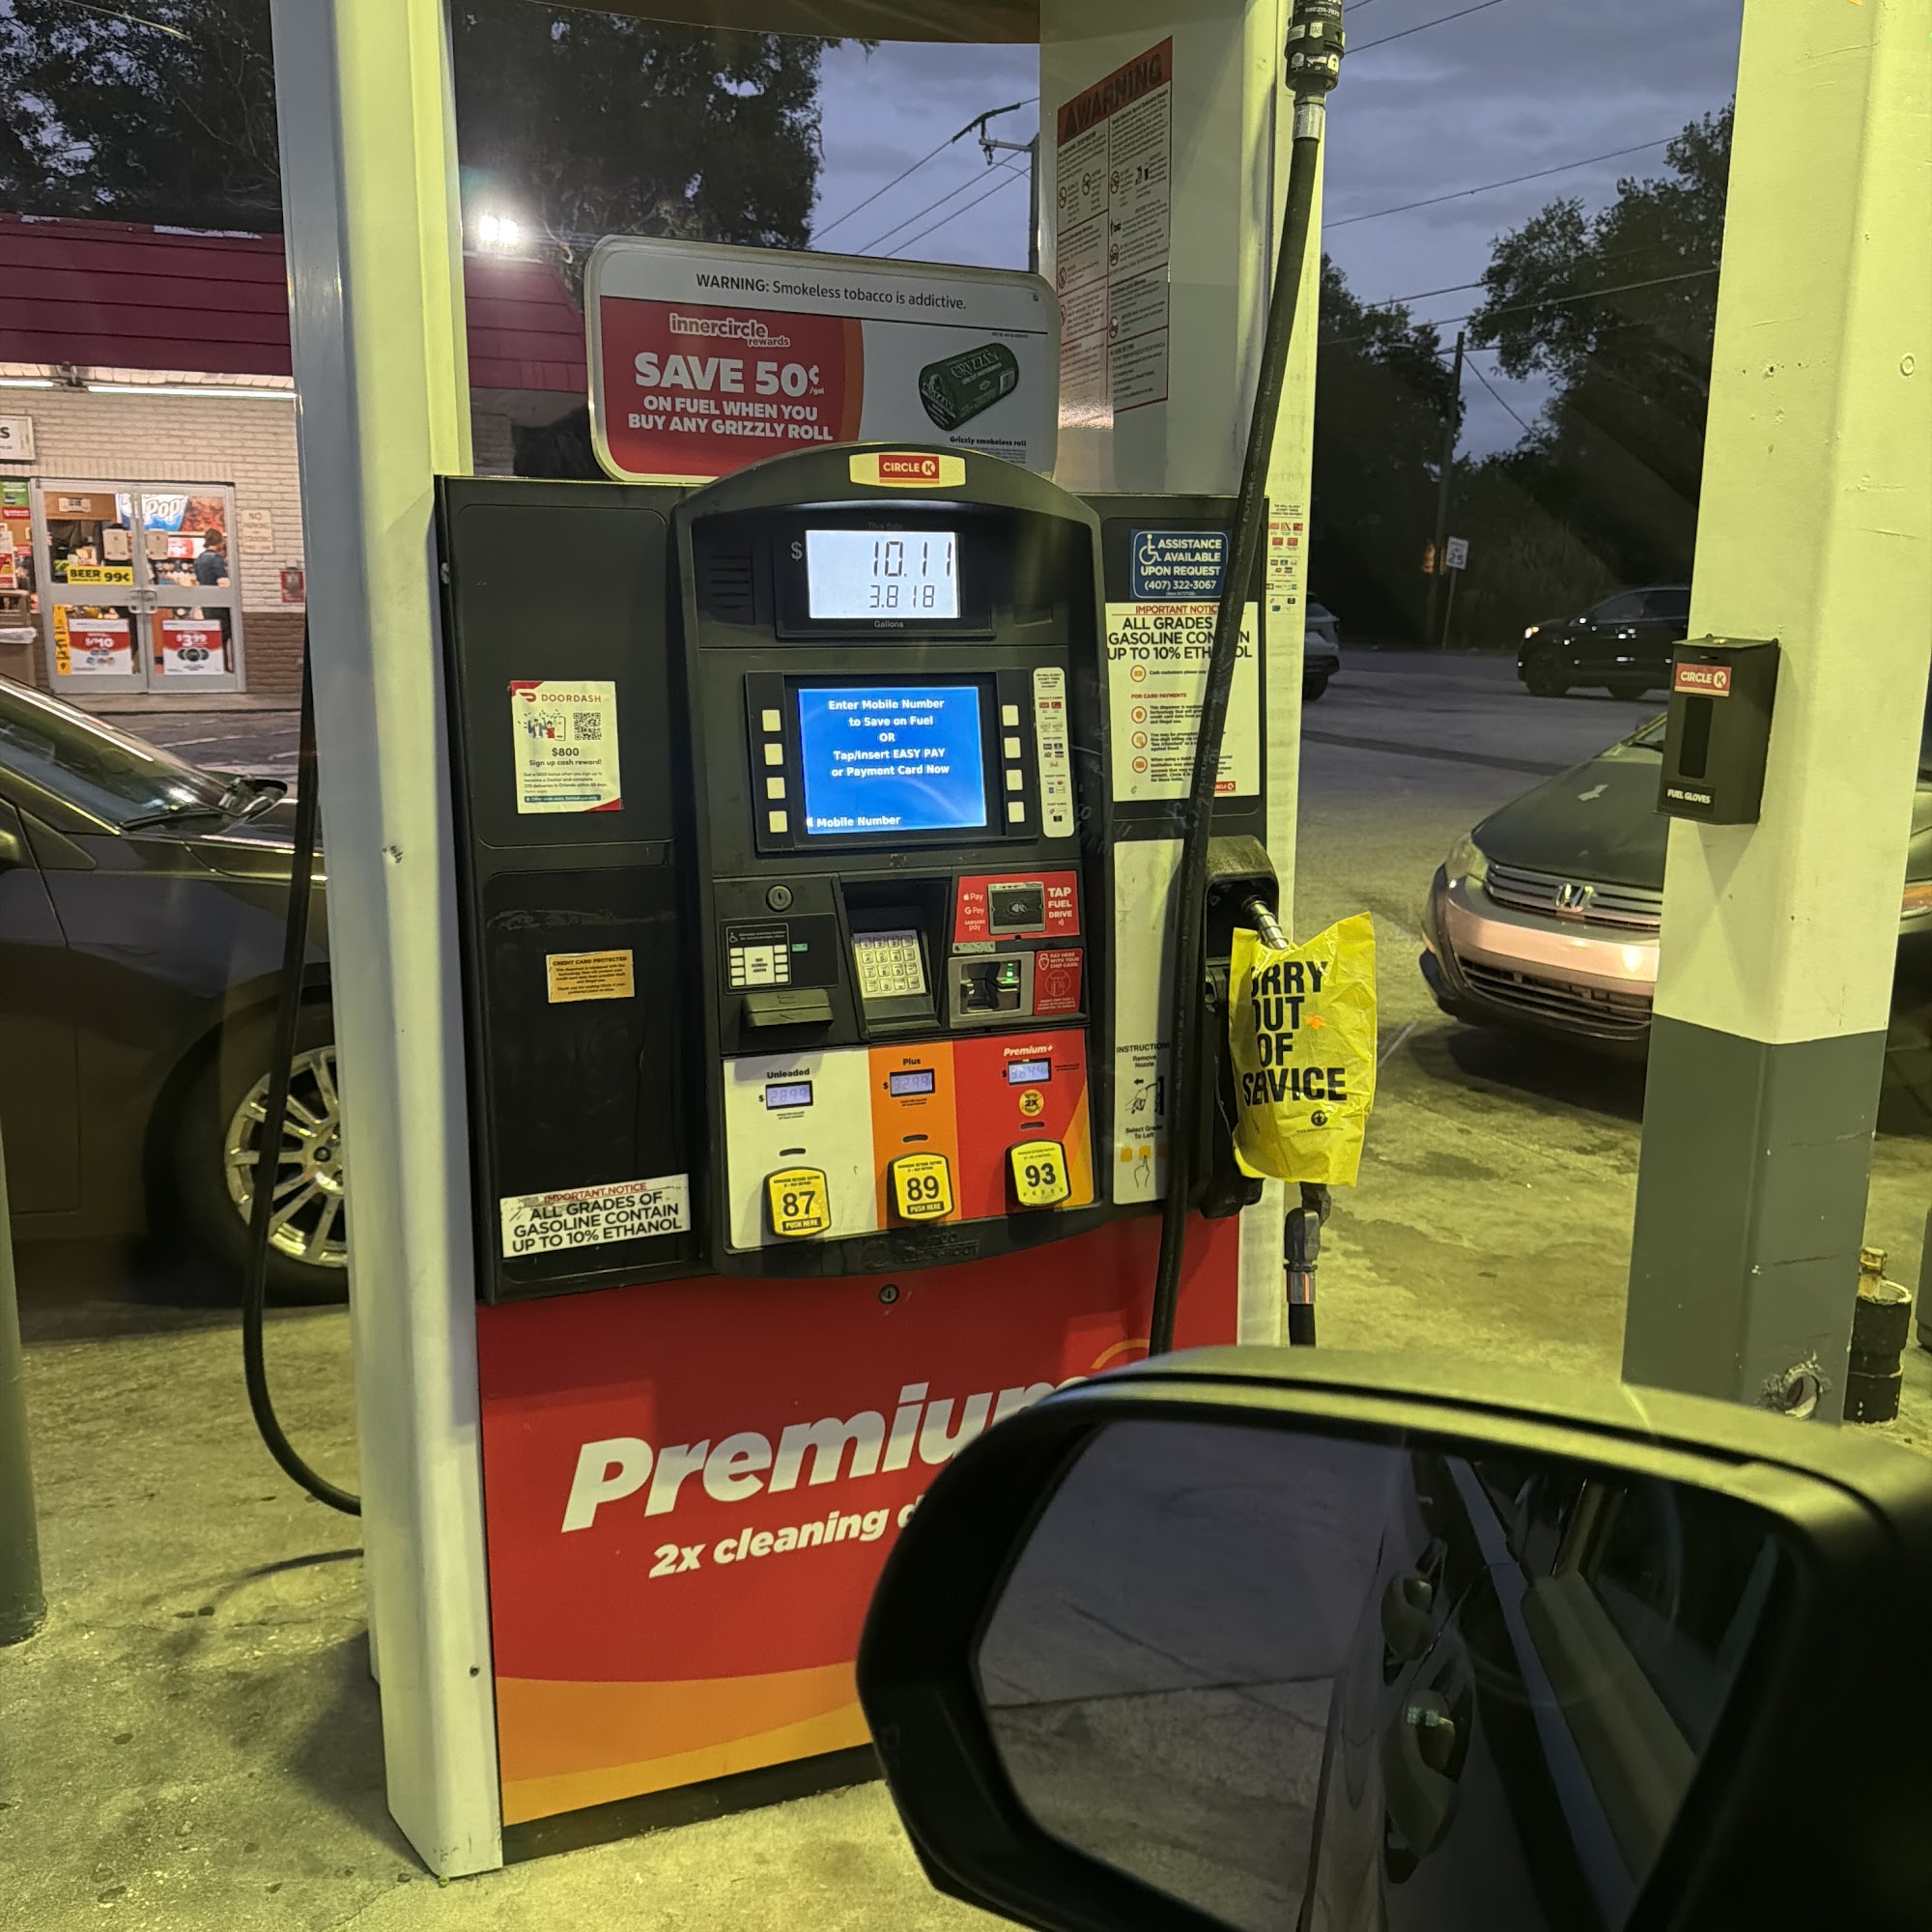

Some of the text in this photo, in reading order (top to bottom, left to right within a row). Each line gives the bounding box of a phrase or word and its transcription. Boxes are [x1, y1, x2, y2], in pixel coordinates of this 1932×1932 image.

[696, 272, 967, 310] WARNING: Smokeless tobacco is addictive.
[670, 314, 768, 338] innercircle
[748, 335, 790, 347] rewards
[635, 352, 744, 393] SAVE
[644, 395, 817, 421] ON FUEL WHEN YOU
[628, 413, 834, 441] BUY ANY GRIZZLY ROLL
[950, 437, 975, 446] Grizzly
[977, 438, 1012, 446] smokeless
[883, 460, 936, 476] CIRCLE K
[1158, 539, 1222, 549] ASSISTANCE
[791, 541, 952, 578] $ 10.11
[1164, 553, 1221, 562] AVAILABLE
[70, 569, 130, 582] BEER 99¢
[1141, 566, 1221, 576] UPON REQUEST
[1145, 581, 1216, 590] (407) 322-3067
[869, 584, 935, 610] 3.818
[1136, 605, 1219, 614] IMPORTANT NOTIC
[874, 620, 904, 629] Gallons
[1122, 616, 1213, 630] ALL GRADES
[1108, 632, 1182, 645] GASOLINE
[1107, 645, 1253, 660] UP TO 10% ETHOL
[1680, 670, 1727, 689] CIRCLE K
[541, 694, 602, 703] DOORDASH
[828, 699, 945, 710] Enter Mobile Number
[849, 717, 861, 726] to
[864, 717, 890, 726] Save
[910, 716, 933, 725] Fuel
[879, 732, 895, 743] OR
[552, 747, 580, 757] $800
[833, 748, 946, 762] Tap/Insert EASY PAY
[528, 759, 545, 768] Sign
[831, 764, 950, 778] or Payment Card Now
[1667, 788, 1711, 804] FUEL GLOVES
[816, 816, 901, 827] Mobile Number
[970, 893, 984, 901] Pay
[1047, 887, 1072, 897] TAP
[1048, 900, 1072, 909] FUEL
[1003, 1044, 1054, 1057] Premium+
[1116, 1042, 1171, 1053] INSTRUCTION
[1257, 1033, 1293, 1067] OF
[902, 1057, 921, 1066] Plus
[767, 1067, 810, 1079] Unleaded
[1025, 1162, 1057, 1188] 93
[545, 1182, 647, 1204] IMPORTANT NOTICE
[906, 1175, 939, 1202] 89
[530, 1191, 663, 1221] ALL GRADES OF
[782, 1190, 816, 1217] 87
[910, 1203, 942, 1213] PUSH HERE
[514, 1203, 679, 1237] GASOLINE CONTAIN
[785, 1219, 819, 1230] PUSH HERE
[512, 1218, 682, 1253] UP TO 10% ETHANOL
[648, 1504, 891, 1579] 2x cleaning
